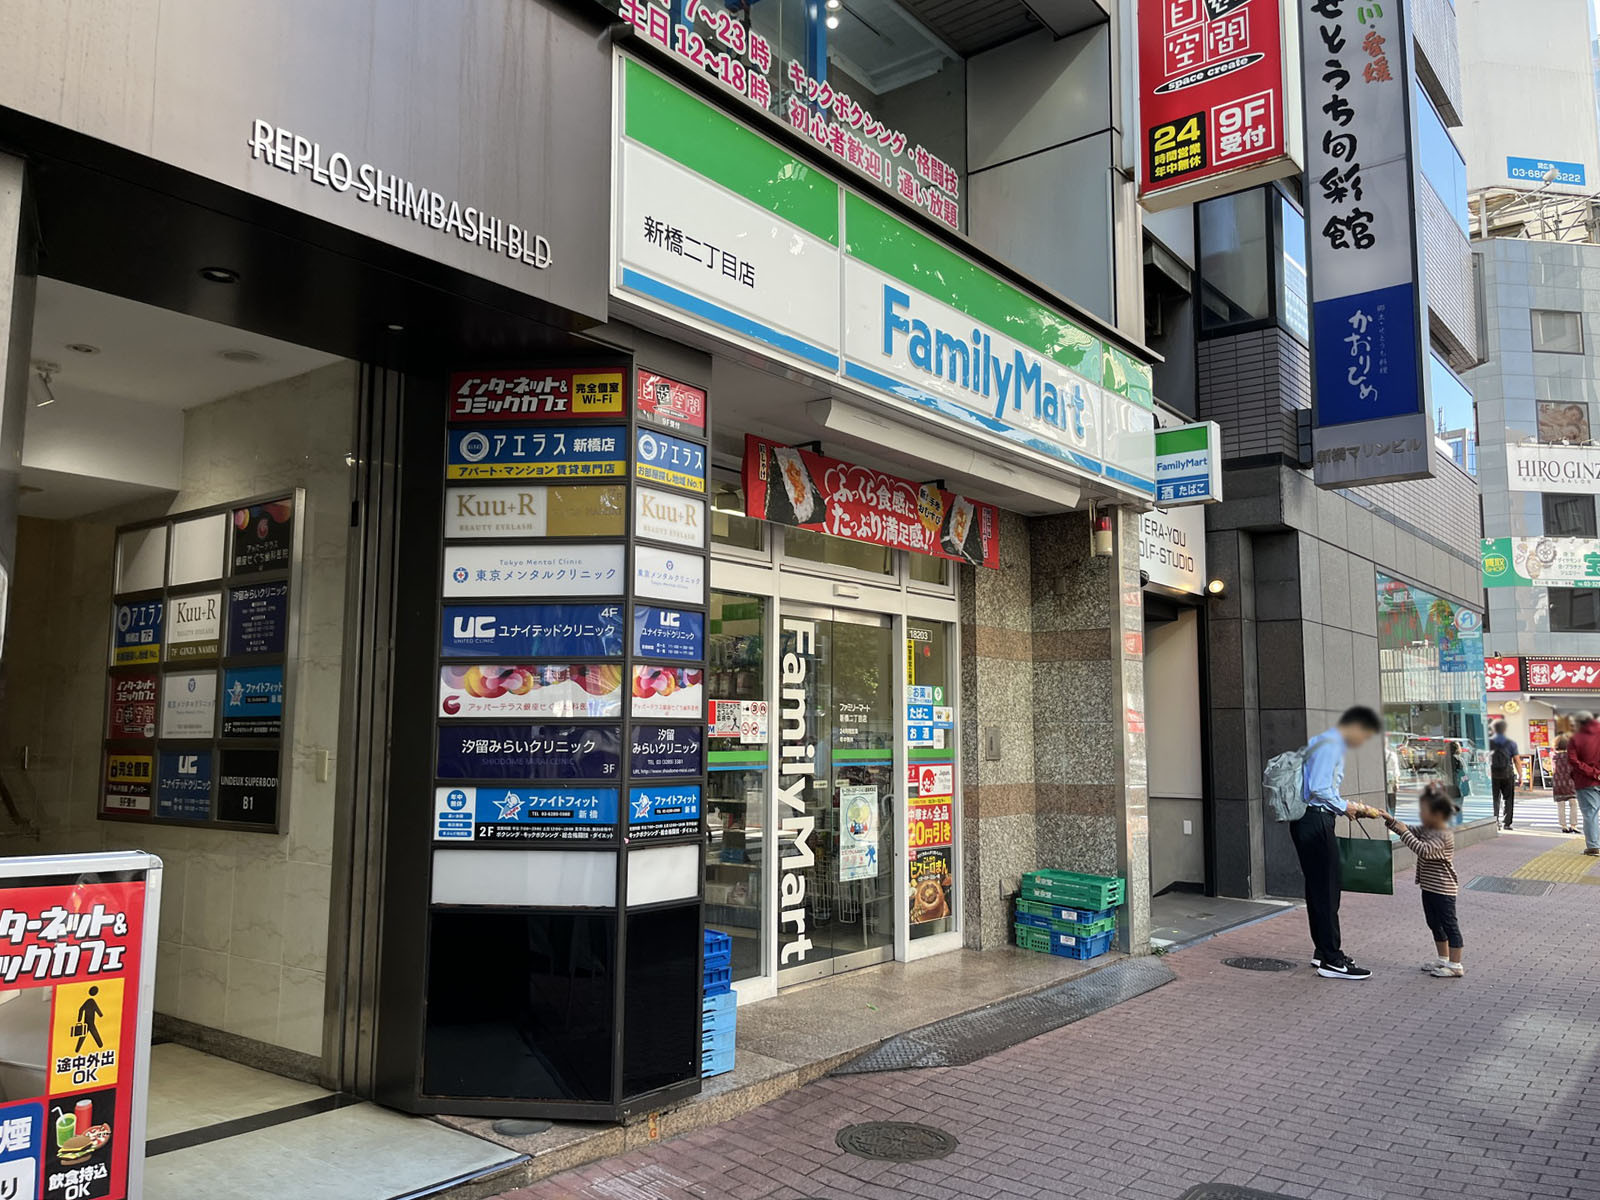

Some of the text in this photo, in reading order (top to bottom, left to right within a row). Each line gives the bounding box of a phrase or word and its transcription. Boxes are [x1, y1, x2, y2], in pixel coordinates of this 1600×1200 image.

[1168, 57, 1249, 91] space create
[1219, 98, 1266, 135] 9F
[1153, 117, 1201, 153] 24
[1220, 125, 1266, 157] 受付
[1154, 142, 1201, 167] 時間営業
[1154, 155, 1202, 178] 年中無休
[248, 118, 554, 270] REPLO SHIMBASHI BLD
[642, 215, 756, 289] 新橋二丁目店
[881, 283, 1084, 440] FamilyMart
[1344, 309, 1379, 402] かおりひめ
[456, 376, 568, 396] インターネット&
[575, 382, 620, 394] 完全個室
[455, 394, 568, 414] コミックカフェ
[582, 394, 613, 405] Wi-Fi
[493, 433, 616, 457] アエラス 新橋店
[659, 441, 703, 471] アエラス
[1156, 457, 1208, 472] FamilyMart
[1517, 459, 1561, 483] HIRO
[687, 477, 703, 490] No.1
[1161, 483, 1206, 500] 酒 たばこ
[456, 492, 537, 517] Kuu+R
[495, 523, 534, 531] EYELASH
[500, 558, 524, 566] Tokyo
[558, 557, 583, 565] Clinic
[475, 568, 617, 582] 東京メンタルクリニック
[601, 607, 619, 618] 4F
[659, 611, 681, 628] UC
[453, 615, 497, 639] UC
[498, 623, 616, 638] ユナイテッドクリニック
[909, 630, 929, 641] 18203
[839, 703, 871, 713] ファミリーマート
[909, 707, 930, 721] たばこ
[657, 728, 675, 741] 汐留
[461, 739, 596, 755] 汐留みらいクリニック
[631, 742, 699, 755] みらいクリニック
[602, 763, 615, 774] 3F
[654, 794, 697, 806] ファイトフィット
[777, 618, 816, 966] FamilyMart
[242, 796, 254, 810] B1
[529, 795, 599, 807] ファイトフィット
[578, 809, 599, 819] 新橋
[479, 826, 495, 837] 2F
[908, 821, 952, 847] 20円引き
[56, 1050, 115, 1074] 途中外出
[72, 1067, 98, 1085] OK
[48, 1163, 108, 1192] 飲食持込
[65, 1182, 92, 1200] OK
